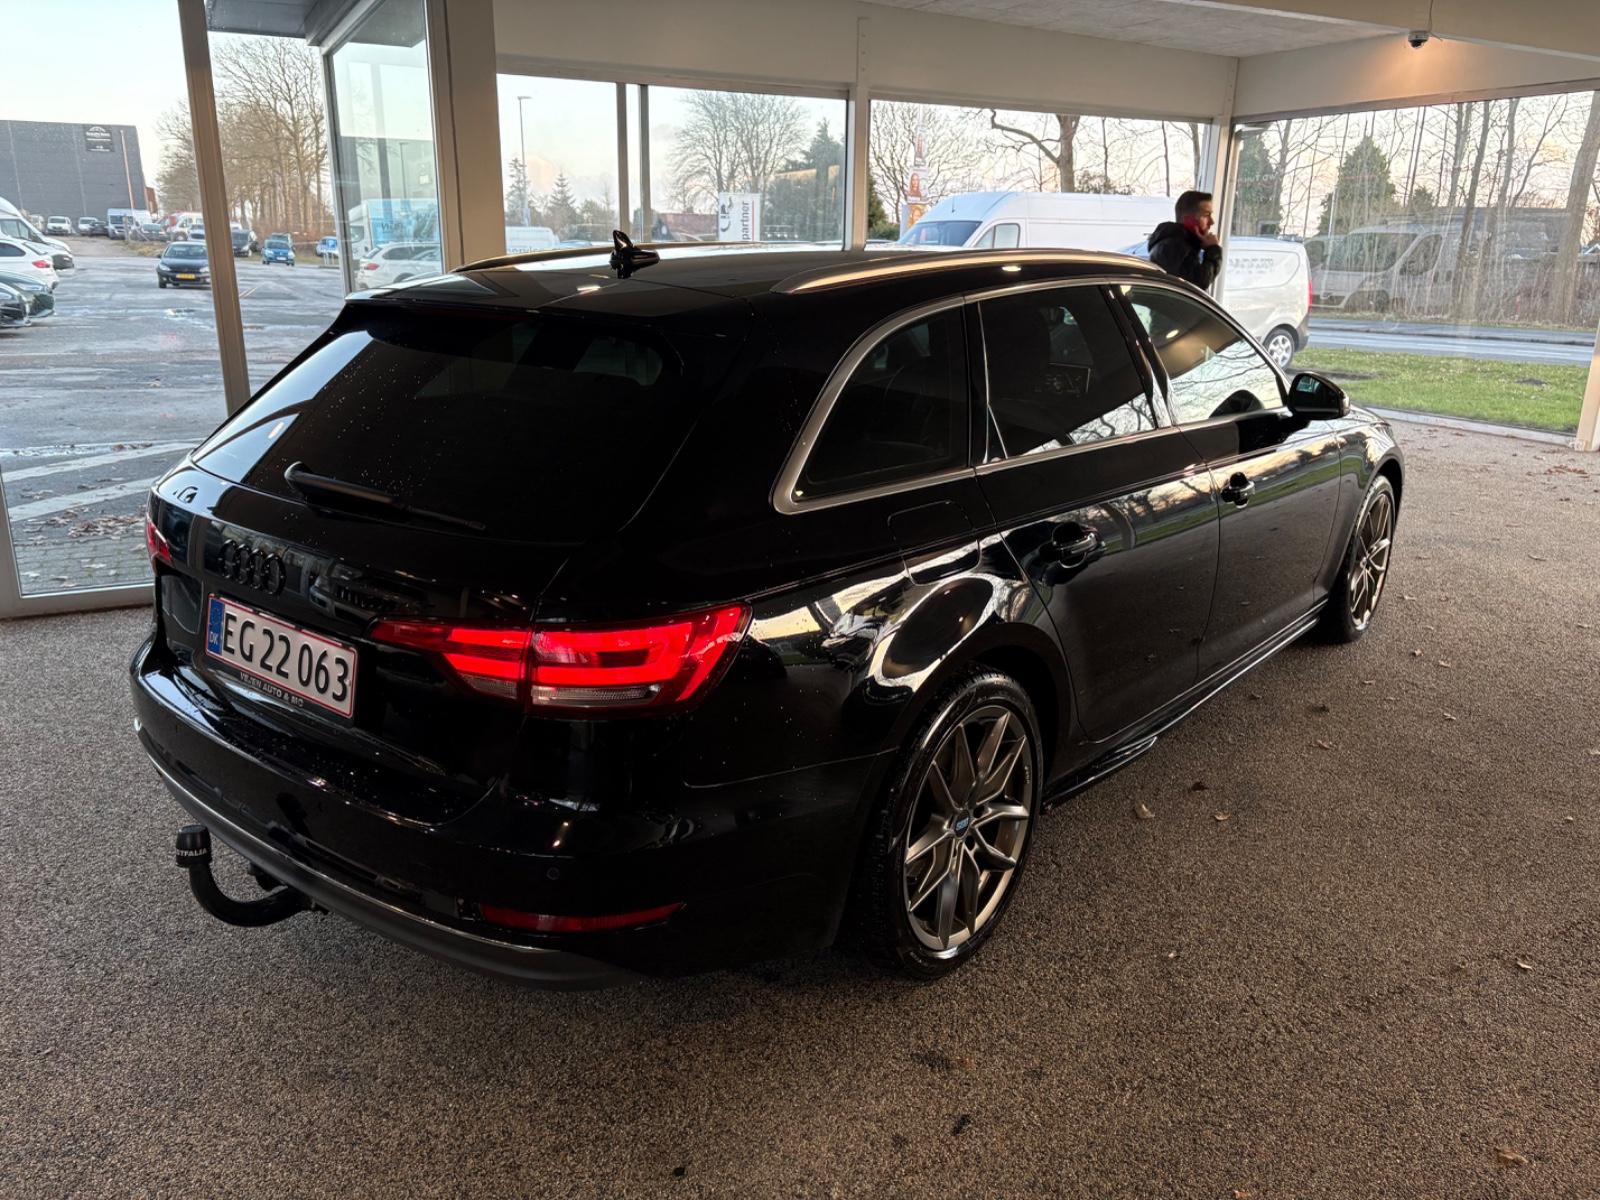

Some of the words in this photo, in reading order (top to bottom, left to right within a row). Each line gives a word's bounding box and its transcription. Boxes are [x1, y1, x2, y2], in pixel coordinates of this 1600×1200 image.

[209, 631, 219, 645] DK
[223, 612, 255, 663] EG
[259, 628, 291, 679] 22
[297, 643, 349, 701] 063
[262, 682, 283, 698] AUTO
